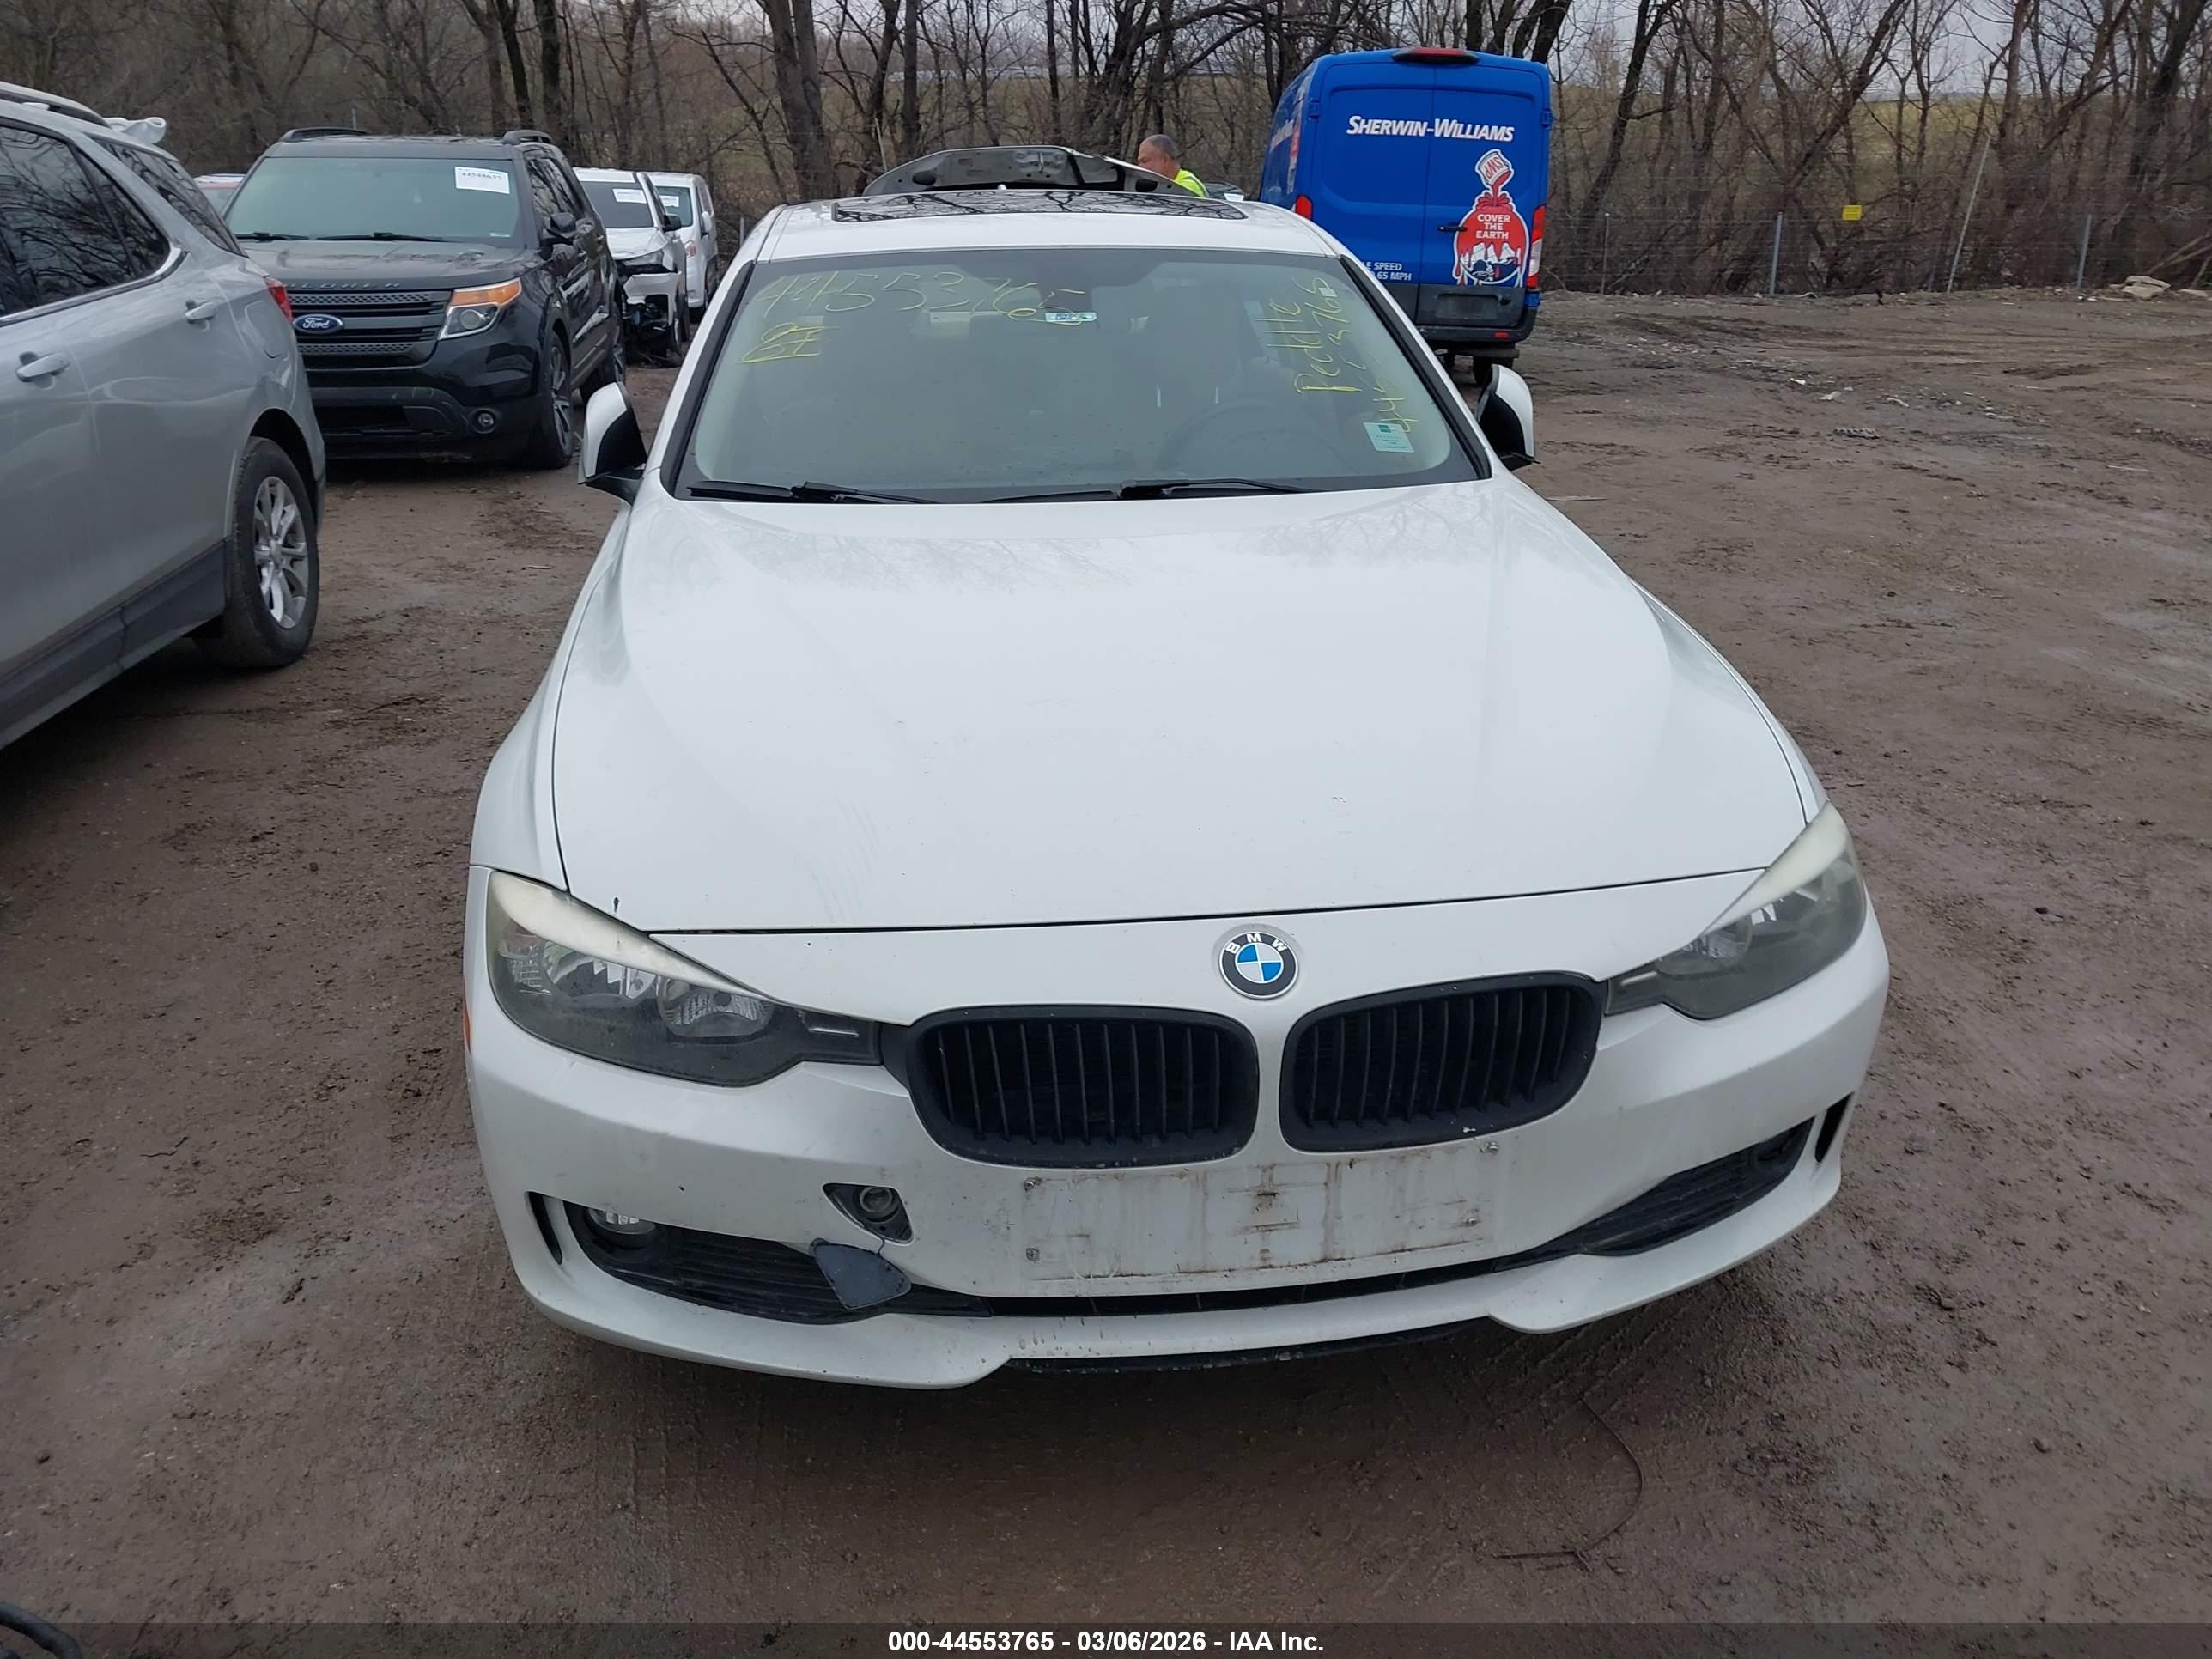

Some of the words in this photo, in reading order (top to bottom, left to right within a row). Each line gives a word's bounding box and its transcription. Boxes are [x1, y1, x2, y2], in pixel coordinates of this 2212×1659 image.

[1346, 115, 1515, 142] SHERWIN-WILLIAMS
[1477, 214, 1511, 222] COVER
[1476, 230, 1509, 240] EARTH
[1374, 261, 1402, 271] SPEED
[1376, 271, 1389, 280] 65
[1390, 271, 1412, 281] MPH
[302, 317, 330, 329] Ford
[1225, 933, 1288, 954] BMW
